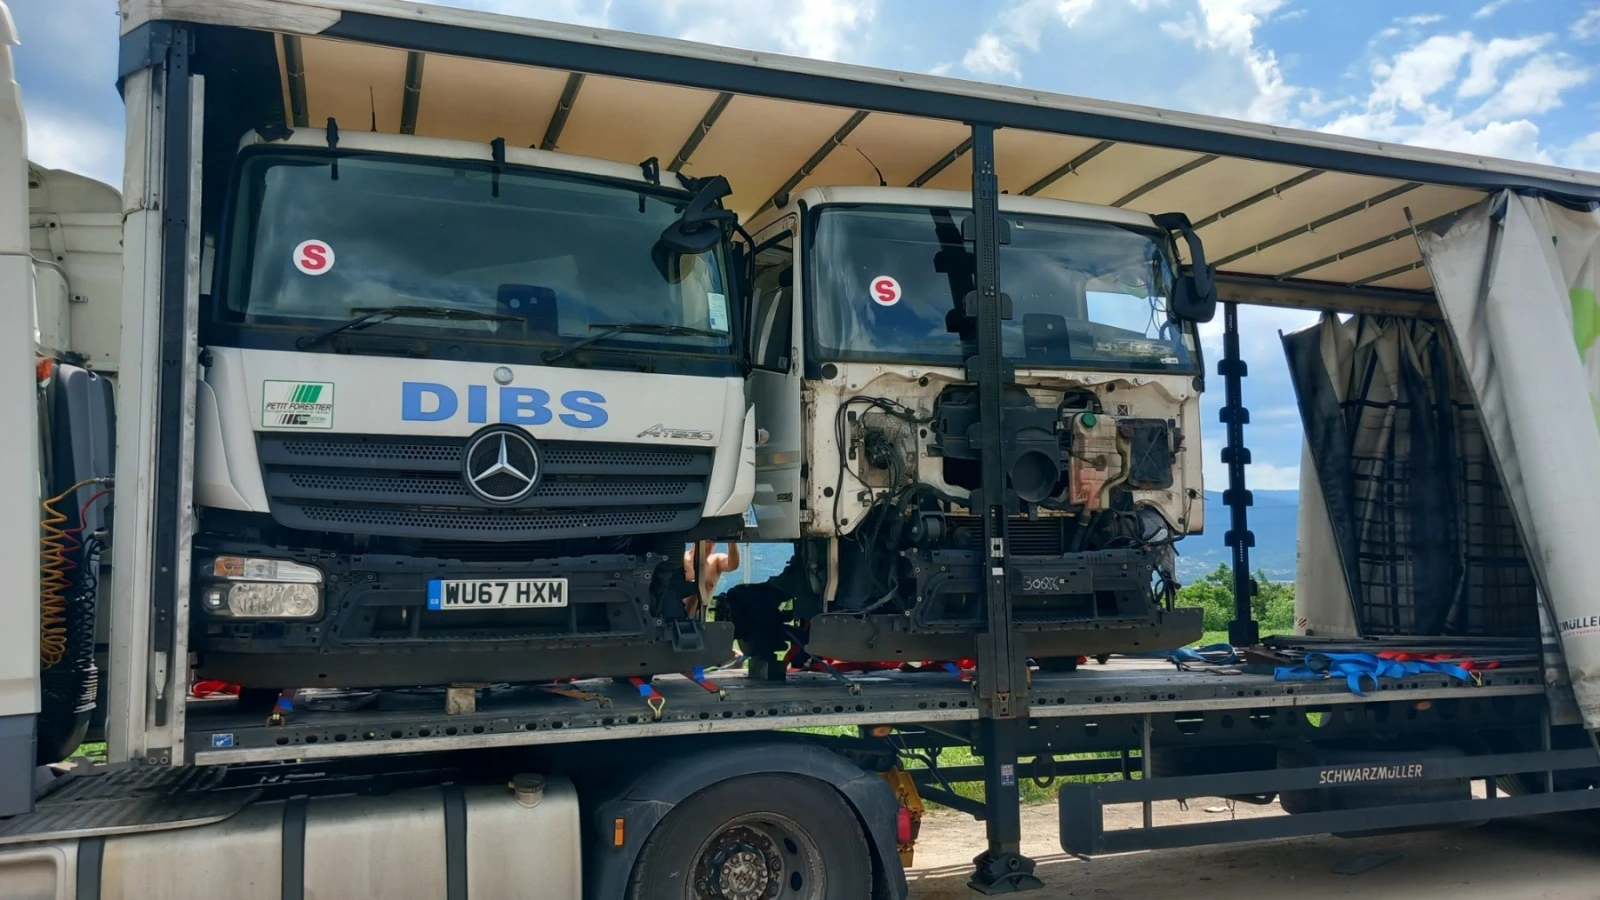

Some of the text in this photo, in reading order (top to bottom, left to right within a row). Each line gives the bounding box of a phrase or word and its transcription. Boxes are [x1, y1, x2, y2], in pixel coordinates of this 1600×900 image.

[301, 244, 326, 270] S
[875, 280, 896, 302] S
[266, 402, 332, 411] PETIT FORESTIER
[402, 382, 608, 429] DIBS
[445, 582, 562, 604] WU67 HXM
[1319, 764, 1422, 784] SCHWARZMÜLLER
